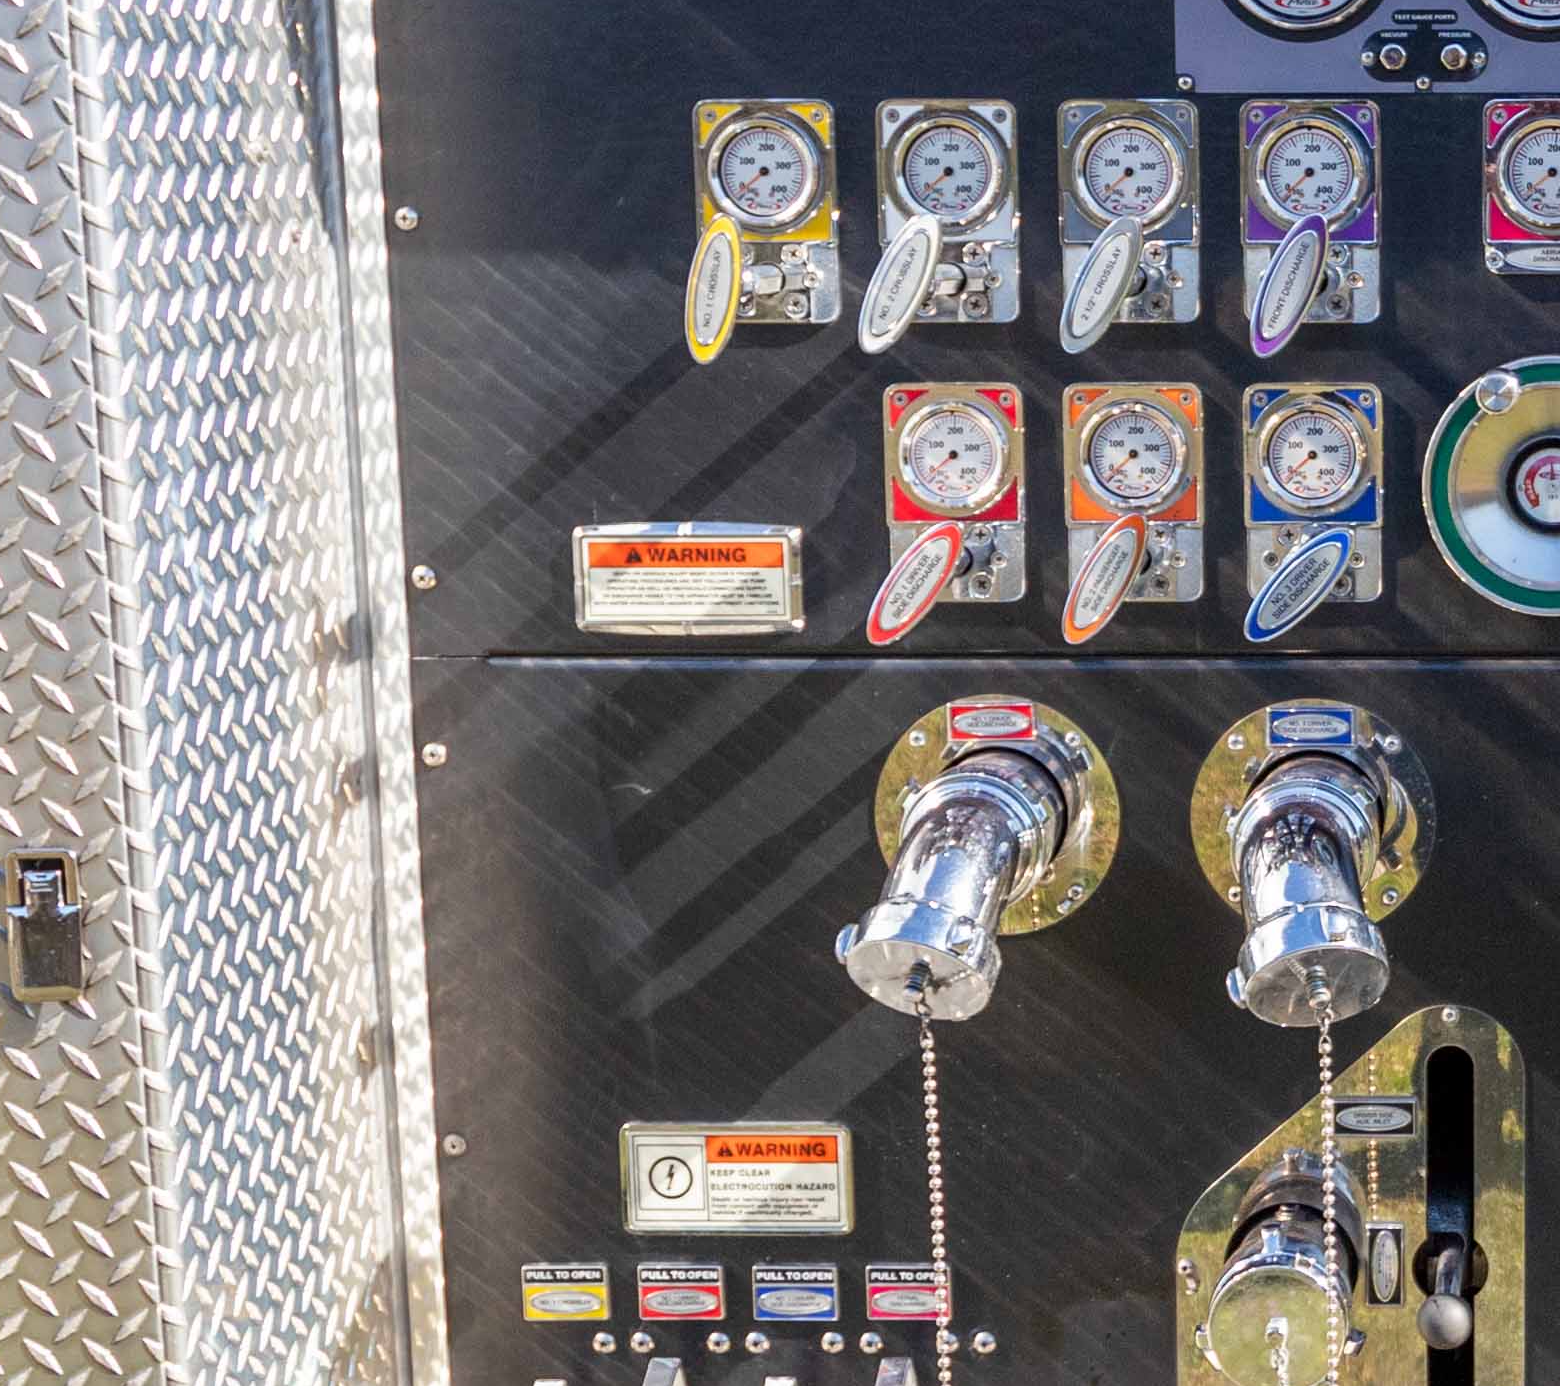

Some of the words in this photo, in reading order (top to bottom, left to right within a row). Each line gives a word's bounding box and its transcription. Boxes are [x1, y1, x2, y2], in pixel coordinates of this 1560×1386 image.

[758, 143, 775, 152] 200
[943, 143, 959, 152] 200
[1123, 145, 1139, 153] 200
[1304, 145, 1321, 153] 200
[739, 157, 755, 165] 100
[1104, 159, 1120, 167] 100
[1284, 159, 1301, 167] 100
[1528, 157, 1544, 166] 100
[959, 162, 975, 170] 300
[1140, 163, 1156, 171] 300
[1321, 163, 1337, 171] 300
[1093, 247, 1122, 295] CROSSLAY
[1268, 300, 1283, 329] FRONT
[1279, 241, 1311, 302] DISCHARGE
[947, 427, 964, 435] 200
[1128, 427, 1144, 435] 200
[1307, 428, 1323, 436] 200
[928, 441, 944, 449] 100
[964, 444, 980, 452] 300
[1108, 440, 1125, 448] 100
[1144, 444, 1160, 452] 300
[1287, 441, 1303, 449] 100
[1322, 445, 1339, 453] 300
[648, 548, 746, 562] WARNING
[1271, 591, 1285, 607] NO.
[1290, 557, 1318, 587] DRIVER
[1271, 599, 1291, 619] SIDE
[1289, 558, 1331, 601] DISCHARGE
[738, 1142, 826, 1157] WARNING
[710, 1169, 736, 1177] KEEP
[738, 1169, 771, 1177] CLEAR
[710, 1183, 791, 1191] ELECTROCUTION
[796, 1183, 835, 1191] HAZARD
[526, 1271, 553, 1280] PULL
[556, 1271, 569, 1280] TO
[572, 1271, 601, 1280] OPEN
[641, 1271, 671, 1280] PULL
[672, 1271, 685, 1280] TO
[687, 1271, 718, 1280] OPEN
[756, 1272, 784, 1281] PULL
[787, 1272, 800, 1281] TO
[802, 1272, 833, 1281] OPEN
[870, 1272, 897, 1281] PULL
[900, 1272, 914, 1281] TO
[916, 1272, 936, 1281] OPE
